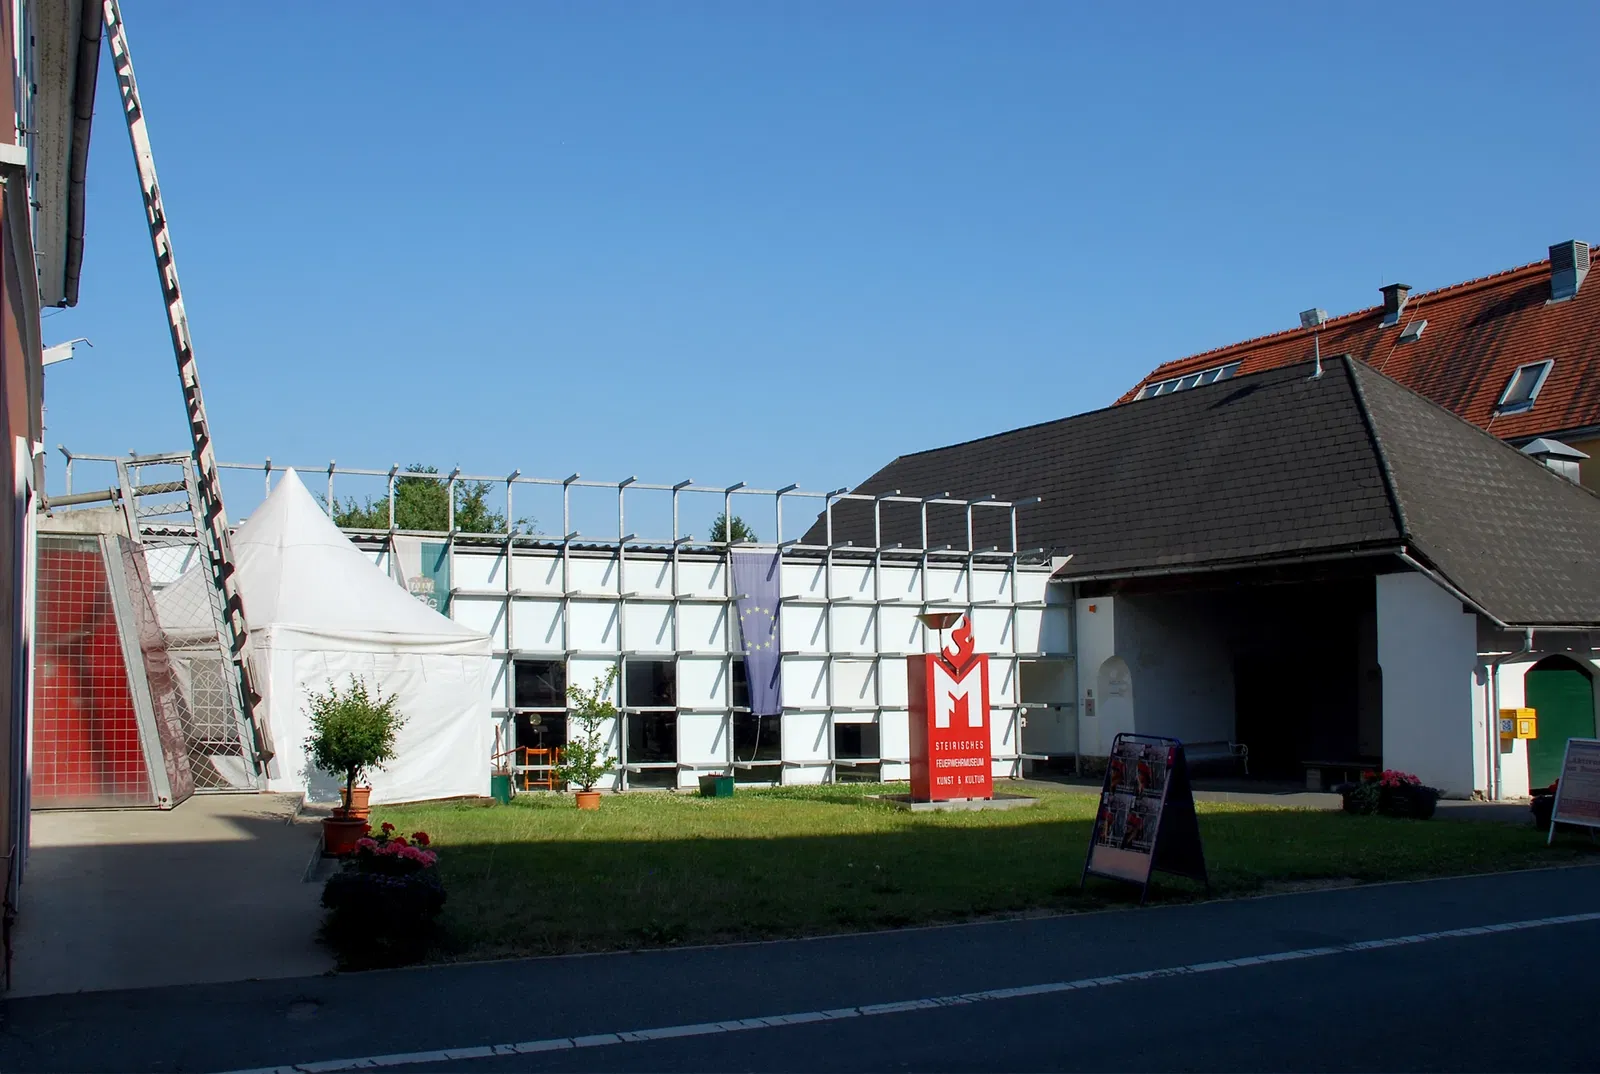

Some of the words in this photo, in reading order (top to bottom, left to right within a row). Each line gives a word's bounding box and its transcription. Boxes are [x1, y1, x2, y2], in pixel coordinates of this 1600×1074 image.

[935, 740, 984, 751] STEIRISCHES
[936, 757, 985, 768] FEUERWEHRMUSEUM
[936, 775, 954, 785] KUNST
[964, 774, 985, 784] KULTUR
